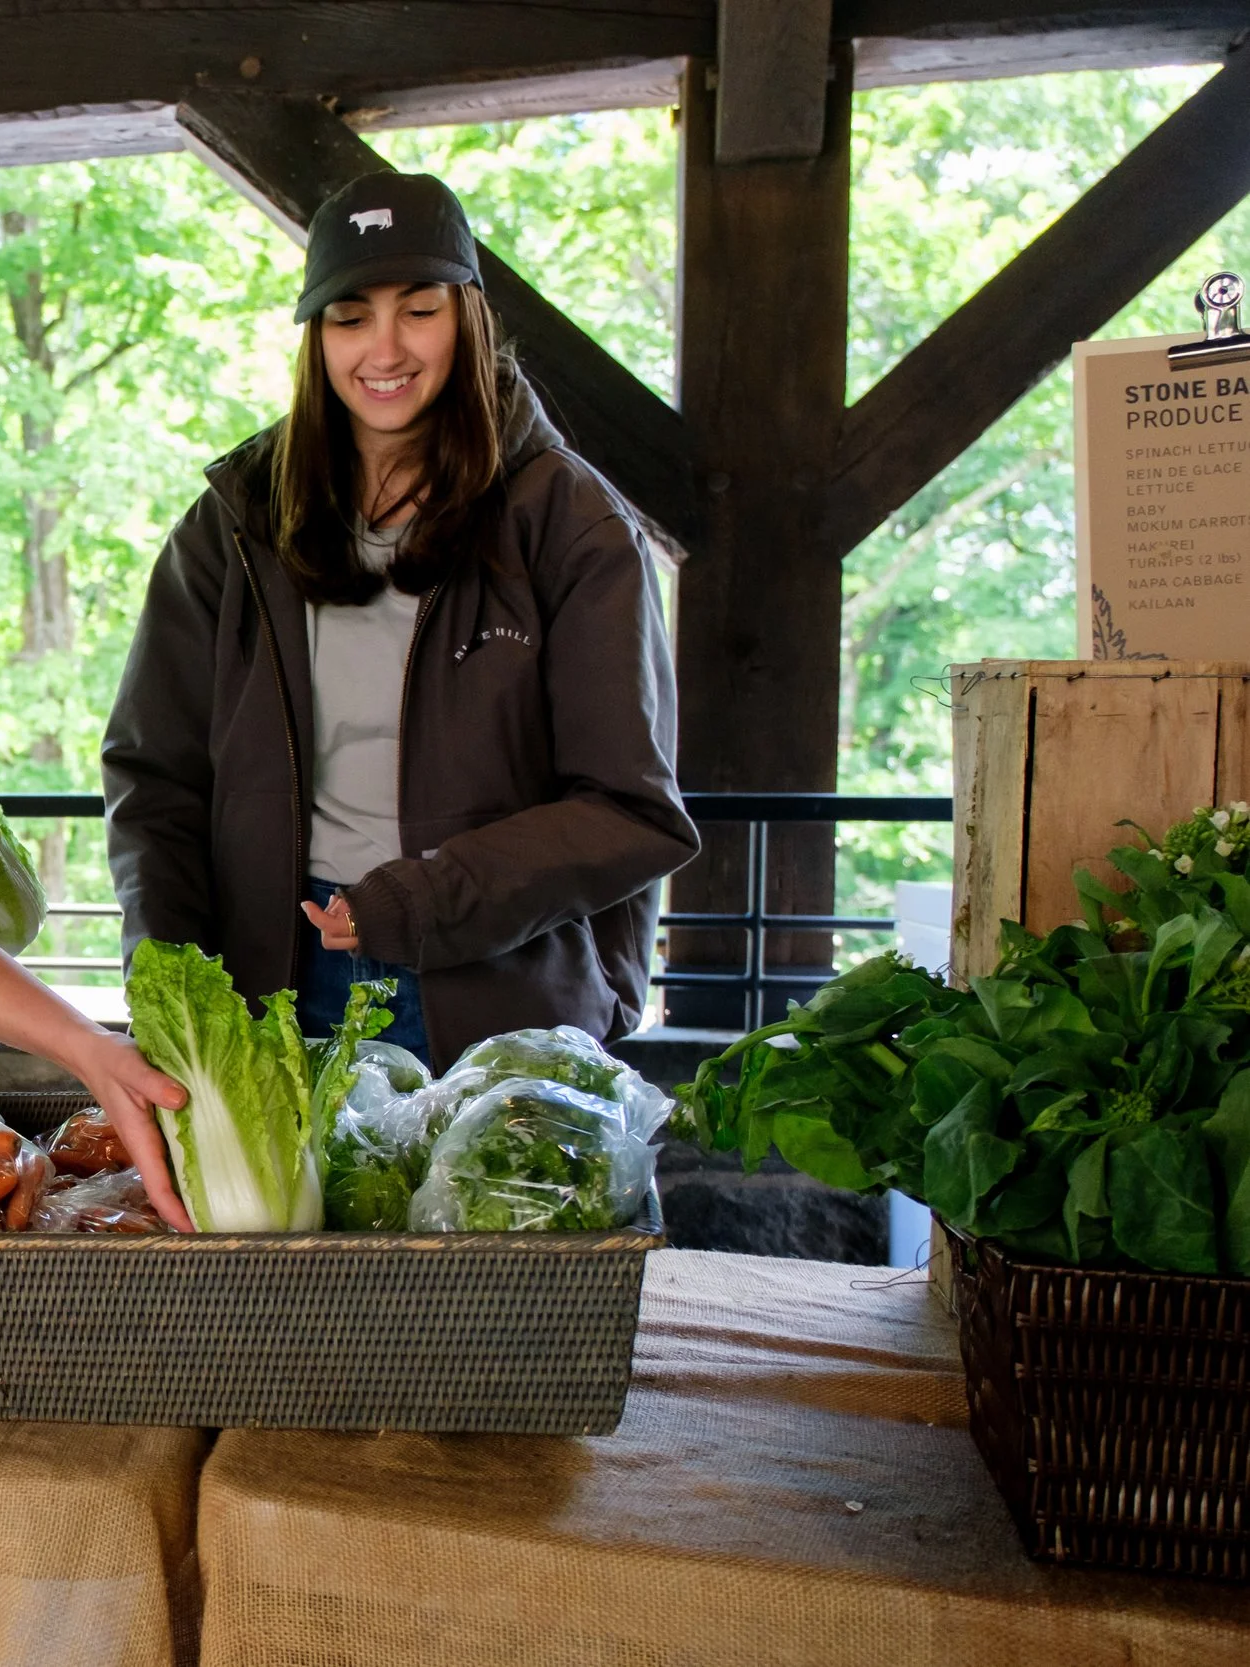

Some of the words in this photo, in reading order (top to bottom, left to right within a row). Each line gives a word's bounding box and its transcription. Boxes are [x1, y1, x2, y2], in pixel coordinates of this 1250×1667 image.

[1125, 380, 1207, 404] STONE
[1216, 376, 1250, 397] BA
[1126, 403, 1243, 430] PRODUCE
[1125, 445, 1192, 460] SPINACH
[1198, 441, 1250, 455] LETTU
[1126, 468, 1163, 480] REIN
[1168, 465, 1188, 478] DE
[1192, 462, 1243, 476] GLACE
[1126, 481, 1196, 497] LETTUCE
[1126, 504, 1167, 517] BABY
[1127, 519, 1183, 533] MOKUM
[1188, 514, 1250, 530] CARROT
[1198, 554, 1213, 566] (2
[1217, 552, 1243, 564] lbs)
[1128, 577, 1168, 590] NAPA
[1172, 573, 1244, 588] CABBAGE
[1128, 597, 1196, 611] KAILAAN
[495, 627, 531, 646] HILL
